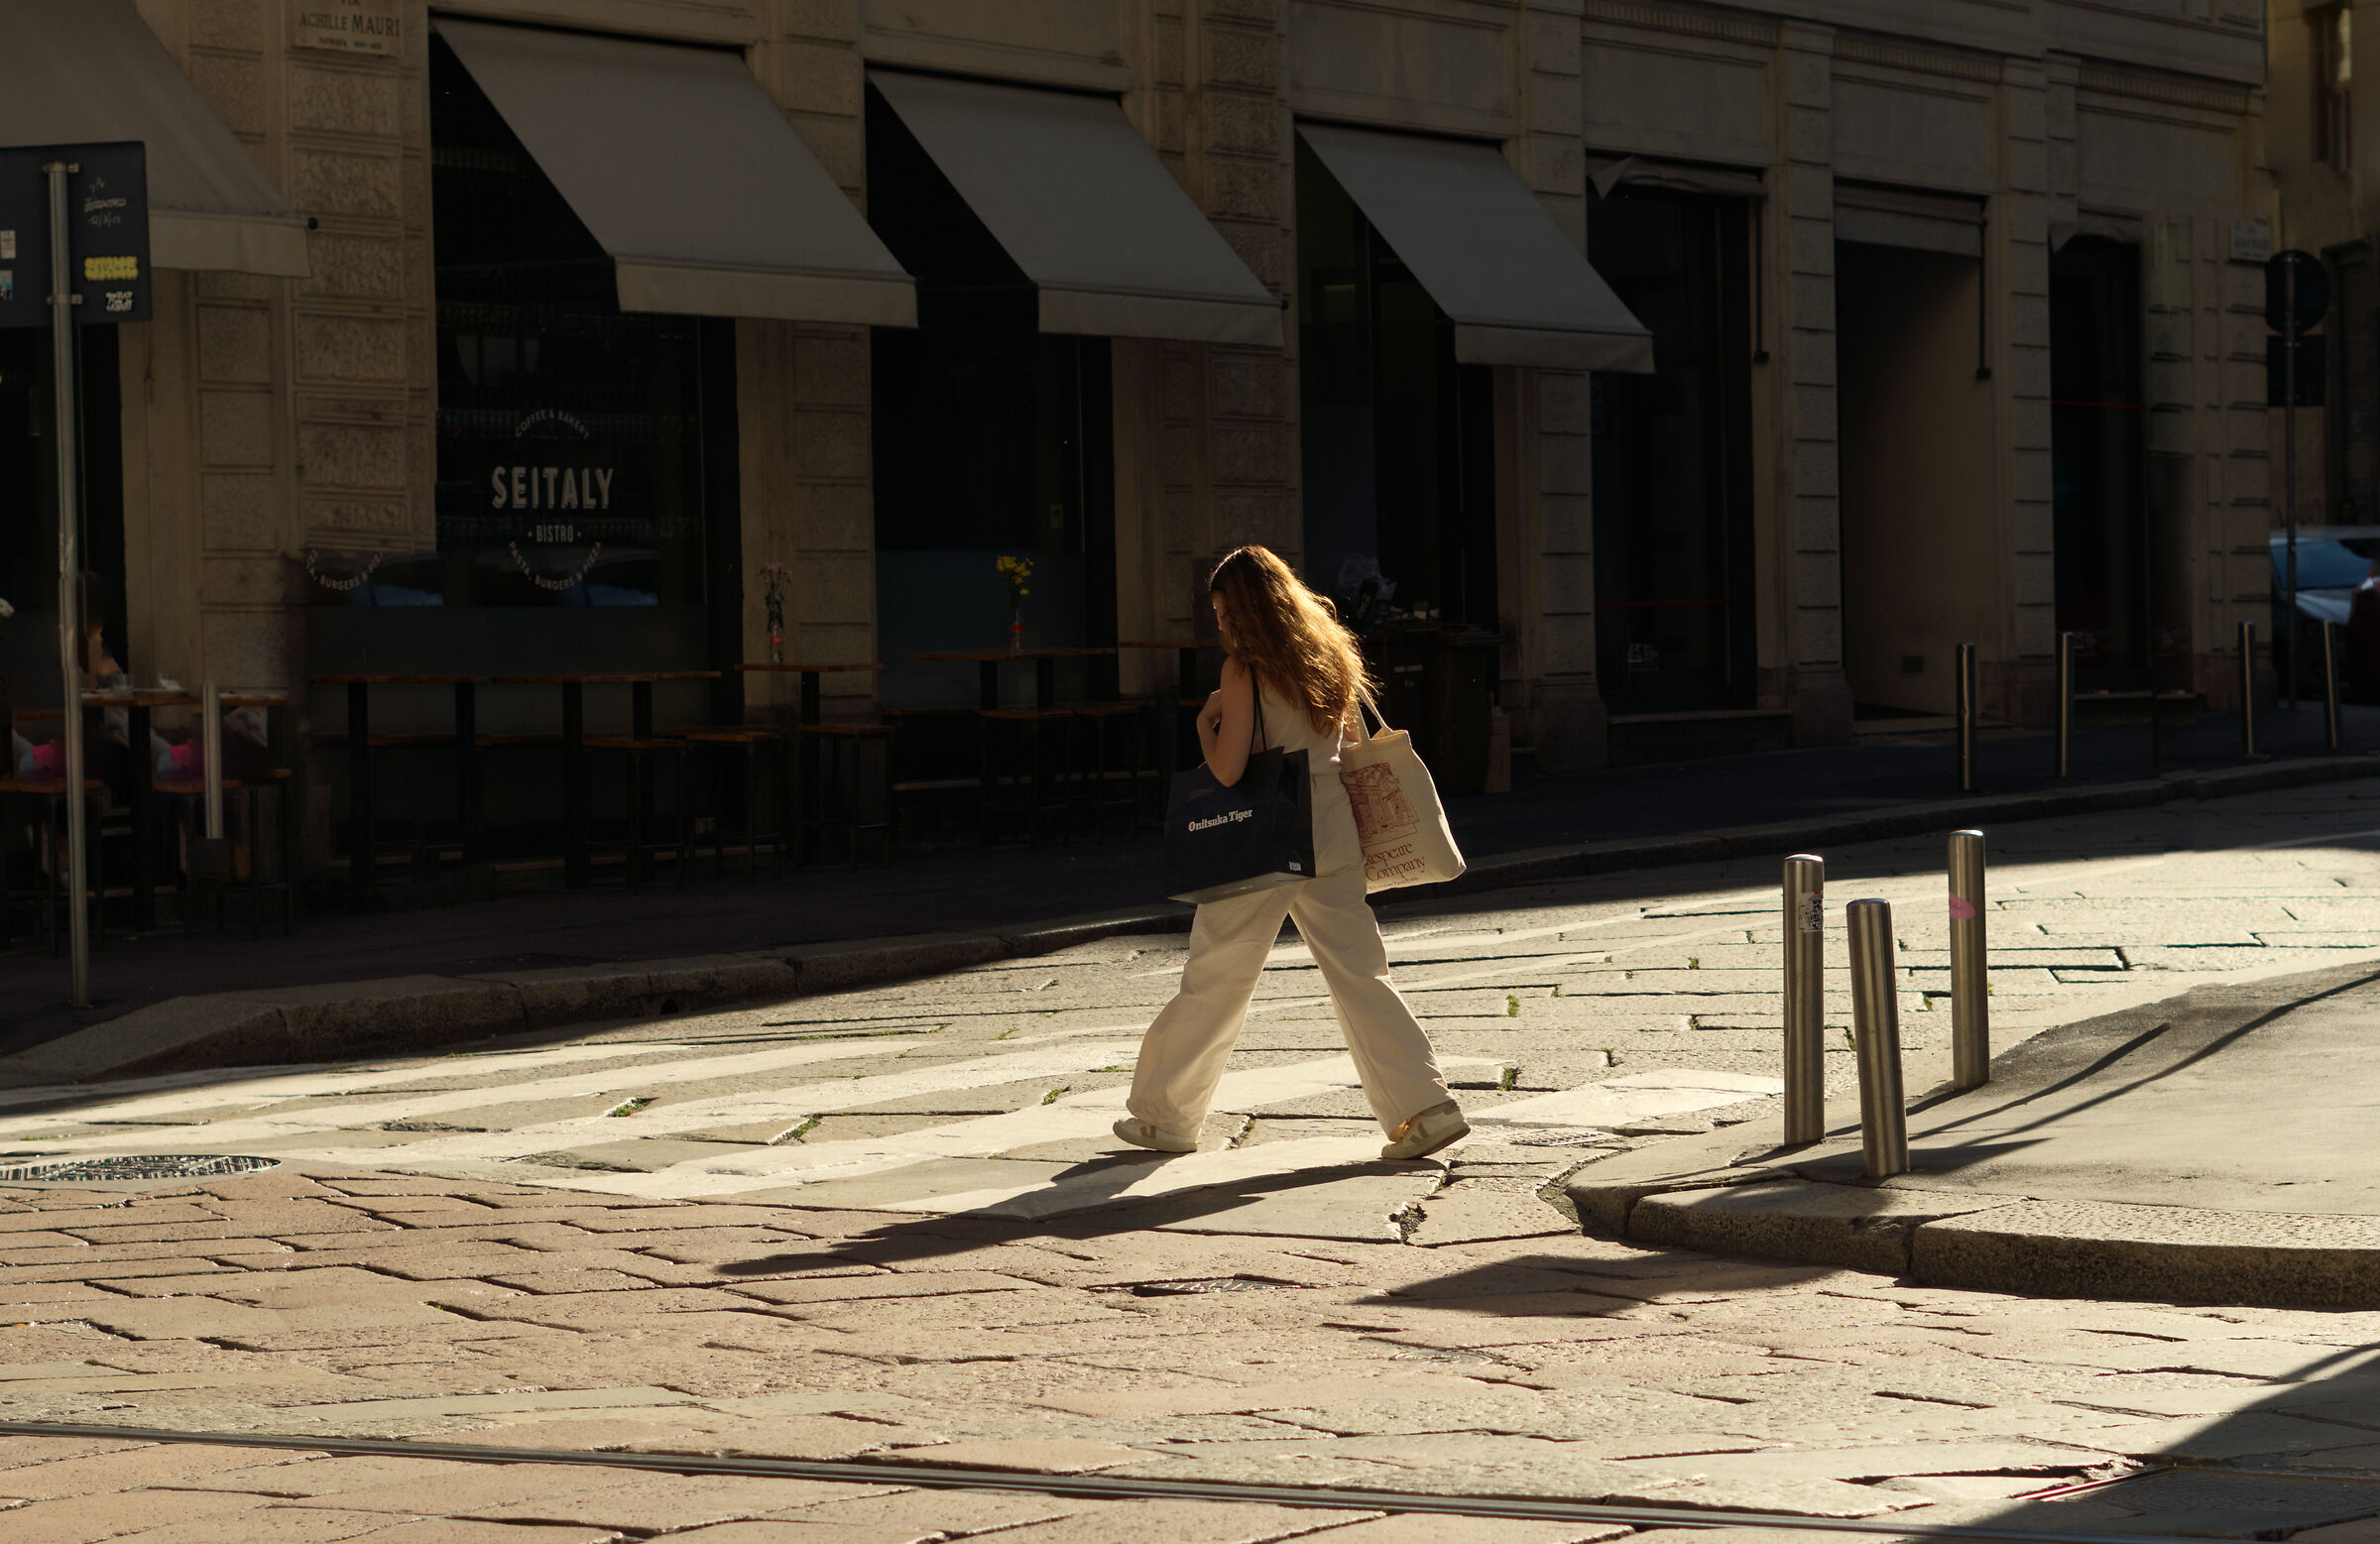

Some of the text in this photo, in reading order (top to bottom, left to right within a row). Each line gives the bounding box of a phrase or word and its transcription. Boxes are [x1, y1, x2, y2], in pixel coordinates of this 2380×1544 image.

[299, 12, 401, 37] ACHILLE MAURI
[516, 408, 546, 437] COFFEE
[557, 410, 590, 440] BAKERY
[491, 465, 615, 509] SEITALY
[536, 524, 574, 543] BISTRO
[535, 574, 575, 592] BURGERS
[582, 540, 603, 574] PIZZA
[1188, 809, 1253, 832] Onitsuka Tiger
[1366, 856, 1426, 881] Company
